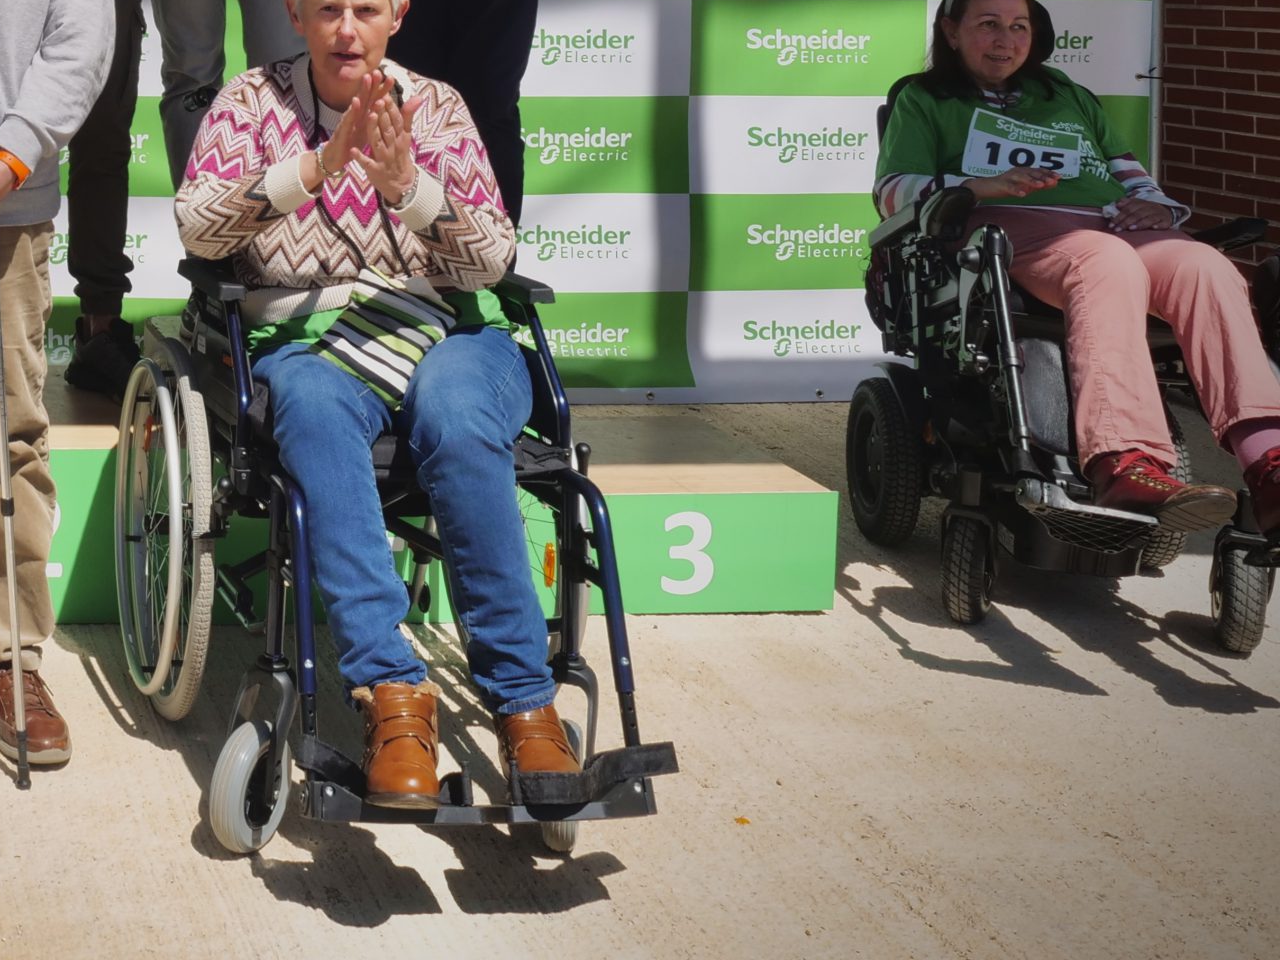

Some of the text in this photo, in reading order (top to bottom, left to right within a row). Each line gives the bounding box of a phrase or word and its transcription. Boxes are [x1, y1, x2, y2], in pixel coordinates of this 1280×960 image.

[531, 28, 635, 49] chneider
[746, 28, 871, 50] Schneider
[565, 50, 632, 63] Electric
[800, 50, 869, 64] Electric
[1045, 51, 1090, 63] ctric
[747, 126, 869, 147] Schneider
[995, 119, 1057, 141] Schneider
[563, 148, 629, 162] Electric
[801, 148, 866, 161] Electric
[985, 141, 1065, 170] 105
[747, 223, 866, 245] Schneider
[560, 246, 630, 259] Electric
[797, 244, 863, 258] Electric
[513, 322, 630, 344] cneider
[743, 319, 862, 341] Schneider
[561, 344, 629, 357] Electric
[795, 341, 862, 355] Electric
[660, 510, 715, 596] 3
